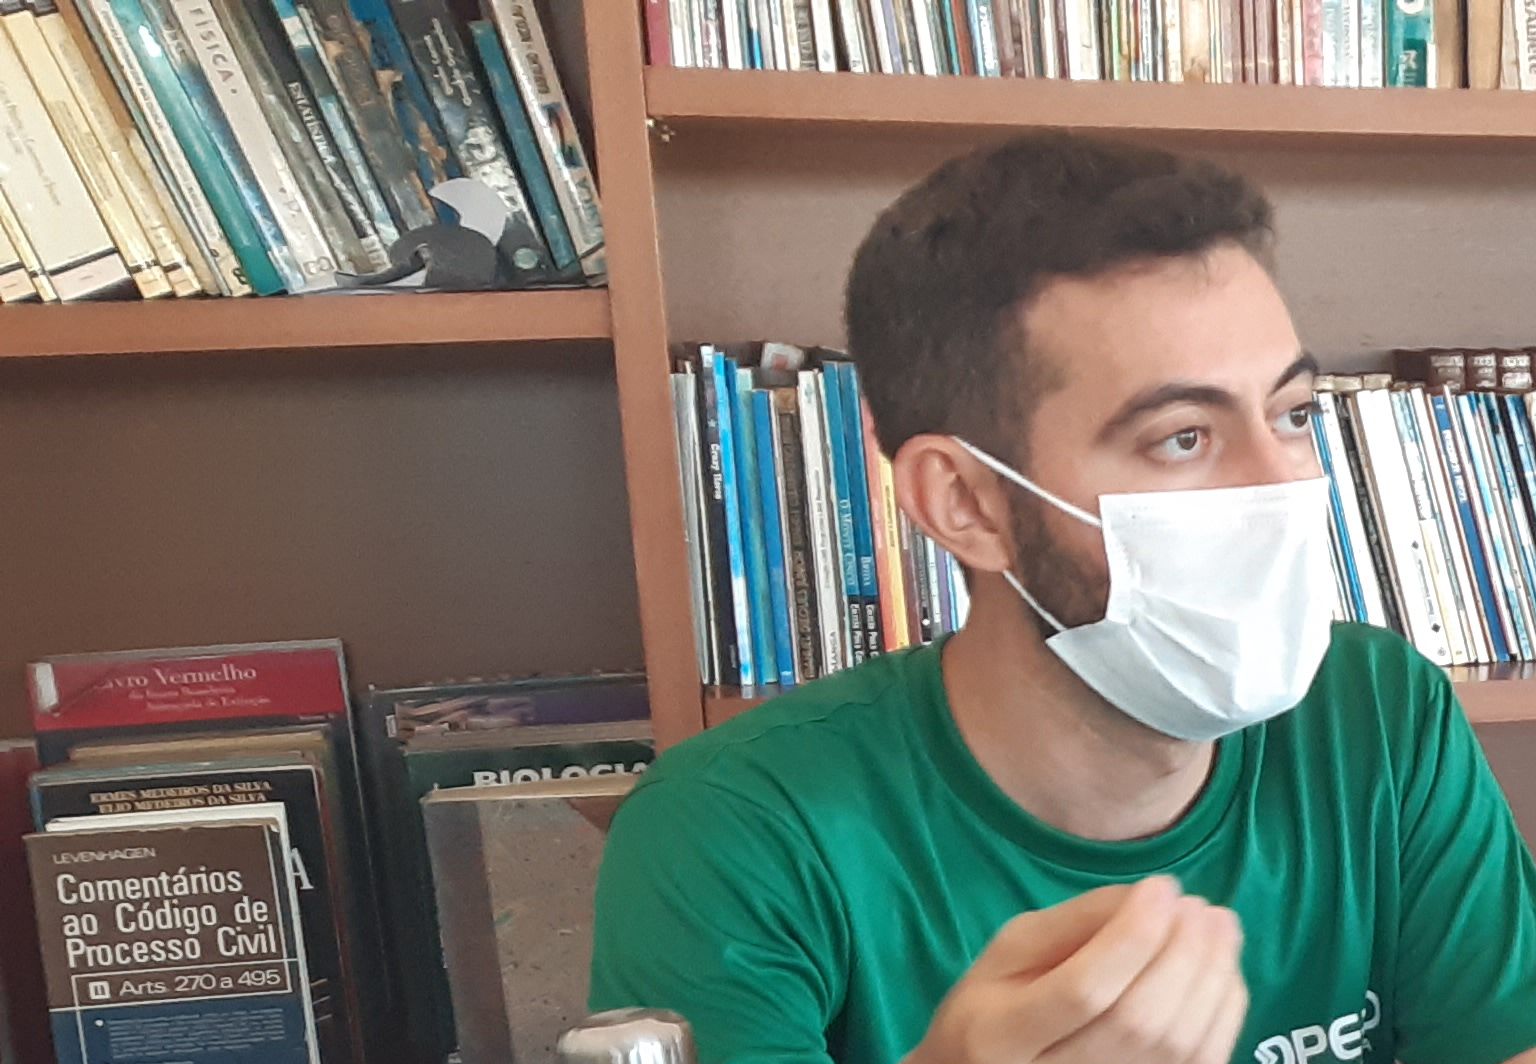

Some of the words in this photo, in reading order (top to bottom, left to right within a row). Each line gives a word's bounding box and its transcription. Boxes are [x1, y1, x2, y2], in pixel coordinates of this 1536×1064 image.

[152, 662, 258, 688] Vermelho
[233, 780, 273, 795] SILVA
[52, 847, 157, 865] LEVENHAGEN
[56, 866, 243, 905] Comentários
[62, 913, 98, 938] ao
[115, 899, 218, 935] Código
[234, 895, 269, 924] de
[65, 937, 201, 969] Processo
[217, 924, 277, 957] Civil
[174, 974, 216, 993] 270
[219, 976, 234, 990] a
[237, 968, 281, 986] 495
